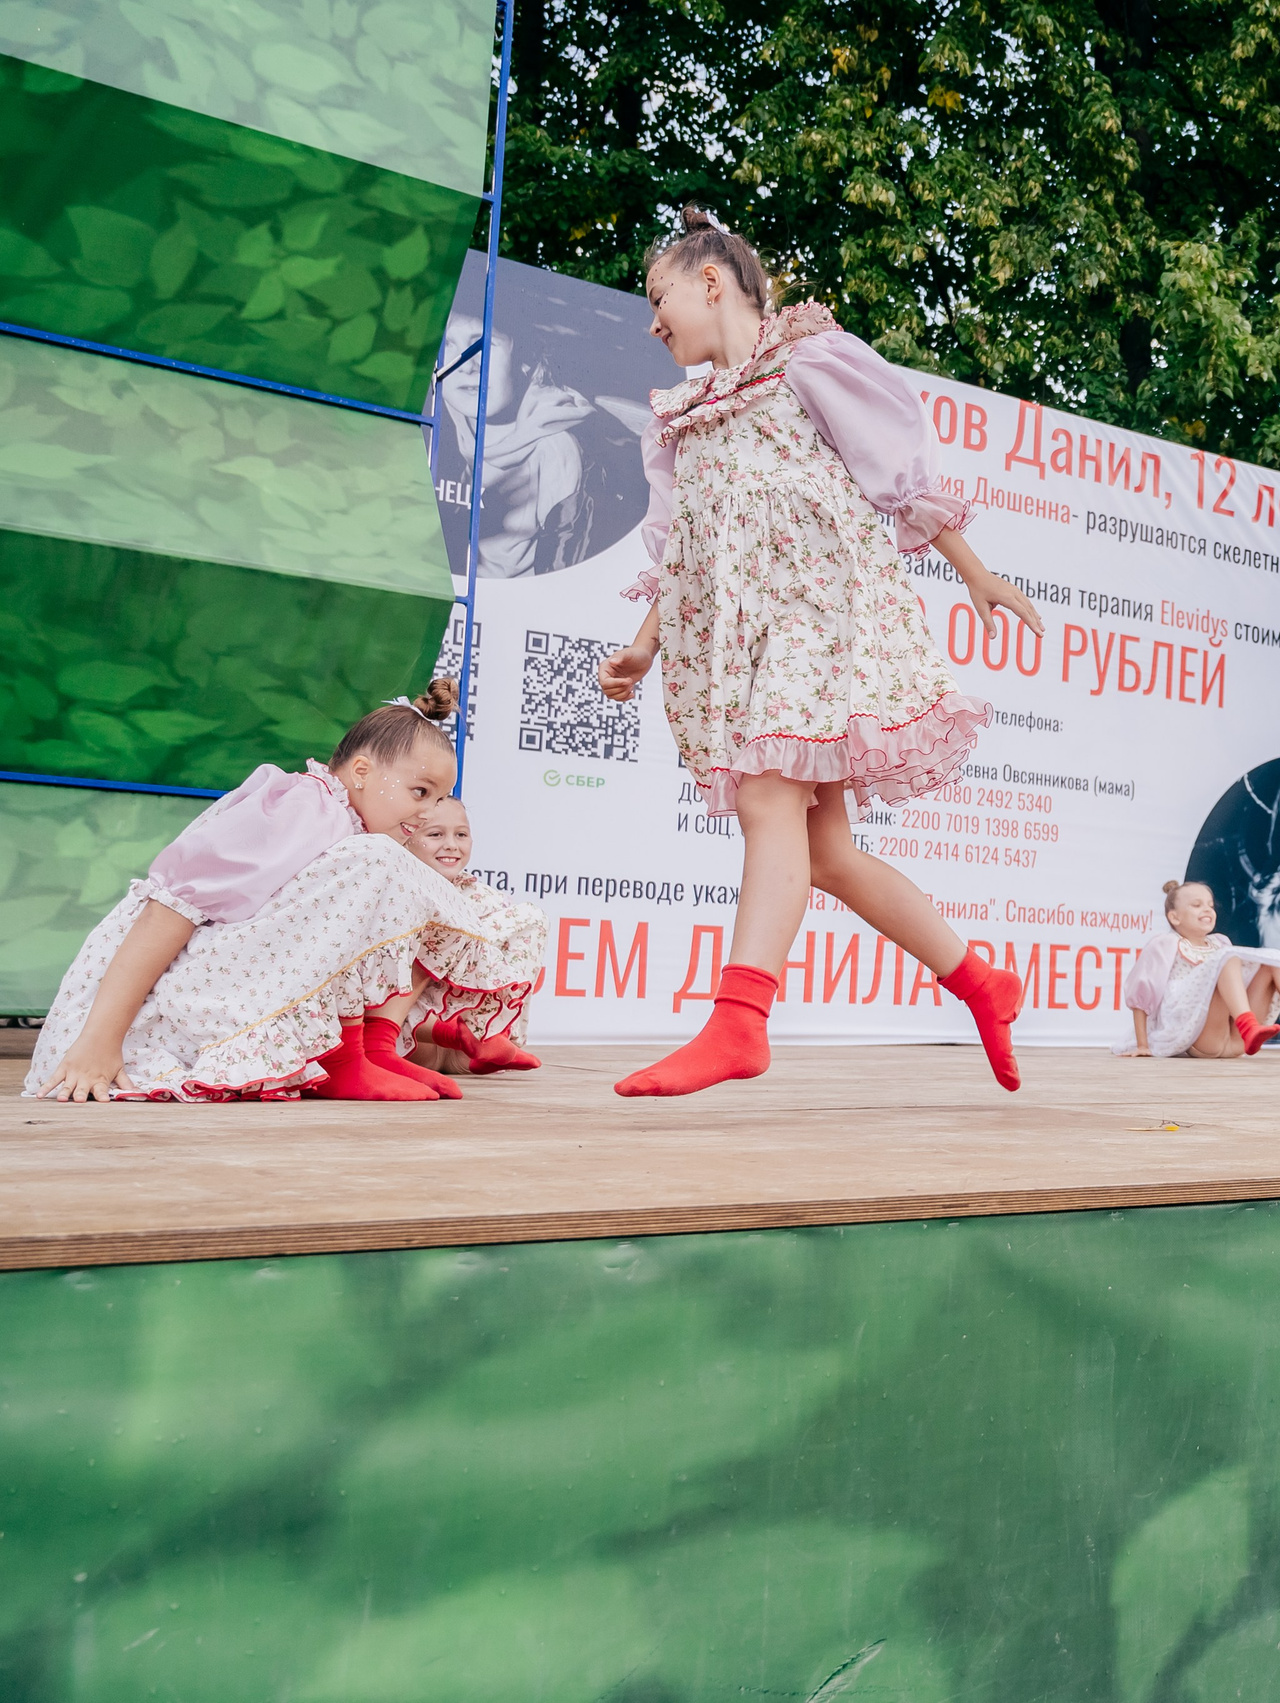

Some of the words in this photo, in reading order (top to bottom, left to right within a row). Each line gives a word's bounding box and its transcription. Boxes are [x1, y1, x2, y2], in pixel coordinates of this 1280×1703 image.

[921, 390, 988, 452] ов
[1004, 398, 1173, 509] Данил,
[1191, 450, 1237, 518] 12
[940, 474, 965, 499] ия
[1086, 509, 1207, 557] разрушаются
[1079, 588, 1154, 624] терапия
[1161, 599, 1229, 640] Elevidys
[1061, 622, 1227, 709] РУБЛЕЙ
[995, 709, 1063, 734] телефона:
[565, 774, 606, 788] СБЕР
[1002, 763, 1089, 792] Овсянникова
[1093, 775, 1136, 802] (мама)
[933, 785, 972, 805] 2080
[977, 787, 1014, 810] 2492
[1017, 795, 1053, 815] 5340
[677, 812, 689, 833] И
[694, 814, 735, 840] СОЦ.
[866, 811, 896, 826] анк:
[901, 808, 941, 832] 2200
[945, 813, 980, 836] 7019
[985, 817, 1019, 840] 1398
[1023, 822, 1060, 843] 6599
[852, 833, 874, 853] ТБ:
[879, 835, 919, 859] 2200
[924, 840, 960, 863] 2414
[964, 844, 1000, 866] 6124
[1003, 848, 1038, 869] 5437
[525, 872, 568, 899] при
[577, 875, 685, 906] переводе
[692, 884, 740, 907] укаж
[924, 893, 1000, 922] анила".
[1006, 899, 1075, 927] Спасибо
[1081, 909, 1153, 934] каждому!
[534, 917, 649, 1000] ЕМ
[672, 924, 942, 1014] ДНИЛА
[967, 939, 1142, 1011] МЕСТ
